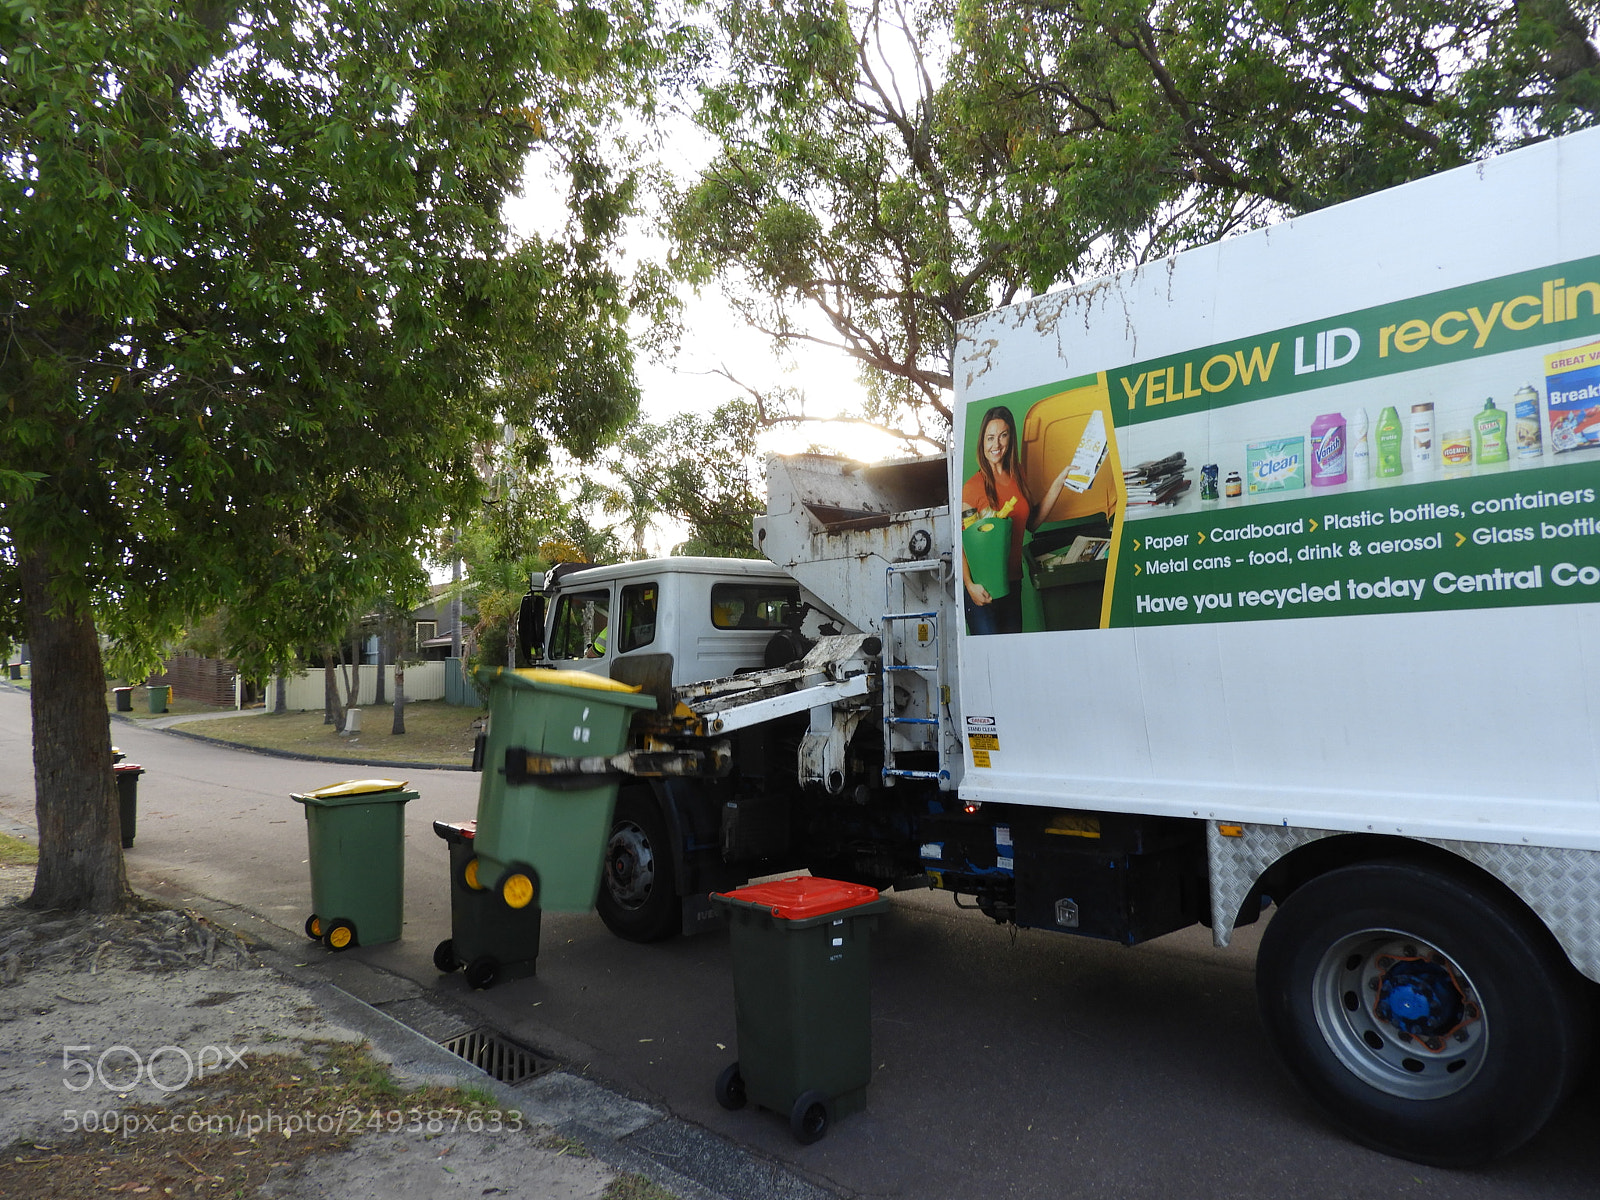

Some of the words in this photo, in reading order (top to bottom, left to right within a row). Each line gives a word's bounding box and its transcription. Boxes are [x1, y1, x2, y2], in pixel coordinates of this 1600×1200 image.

[1120, 341, 1280, 410] YELLOW
[1294, 327, 1361, 376] LID
[1551, 354, 1586, 370] GREAT
[1550, 383, 1600, 405] Break
[1258, 454, 1298, 478] Clean
[1315, 436, 1341, 464] Vanish
[1145, 534, 1189, 551] Paper
[1210, 518, 1304, 543] Cardboard
[1323, 510, 1384, 531] Plastic
[1390, 503, 1466, 524] bottles,
[1471, 488, 1595, 515] containers
[1145, 557, 1188, 575] Metal
[1192, 555, 1232, 571] cans
[1248, 547, 1293, 566] food,
[1297, 543, 1343, 562] drink
[1348, 540, 1362, 557] &
[1367, 532, 1442, 555] aerosol
[1472, 526, 1535, 546] Glass
[1136, 594, 1188, 613] Have
[1193, 592, 1233, 614] you
[1238, 580, 1341, 609] recycled
[1347, 576, 1426, 601] today
[1433, 565, 1543, 594] Central
[1551, 562, 1600, 587] Co
